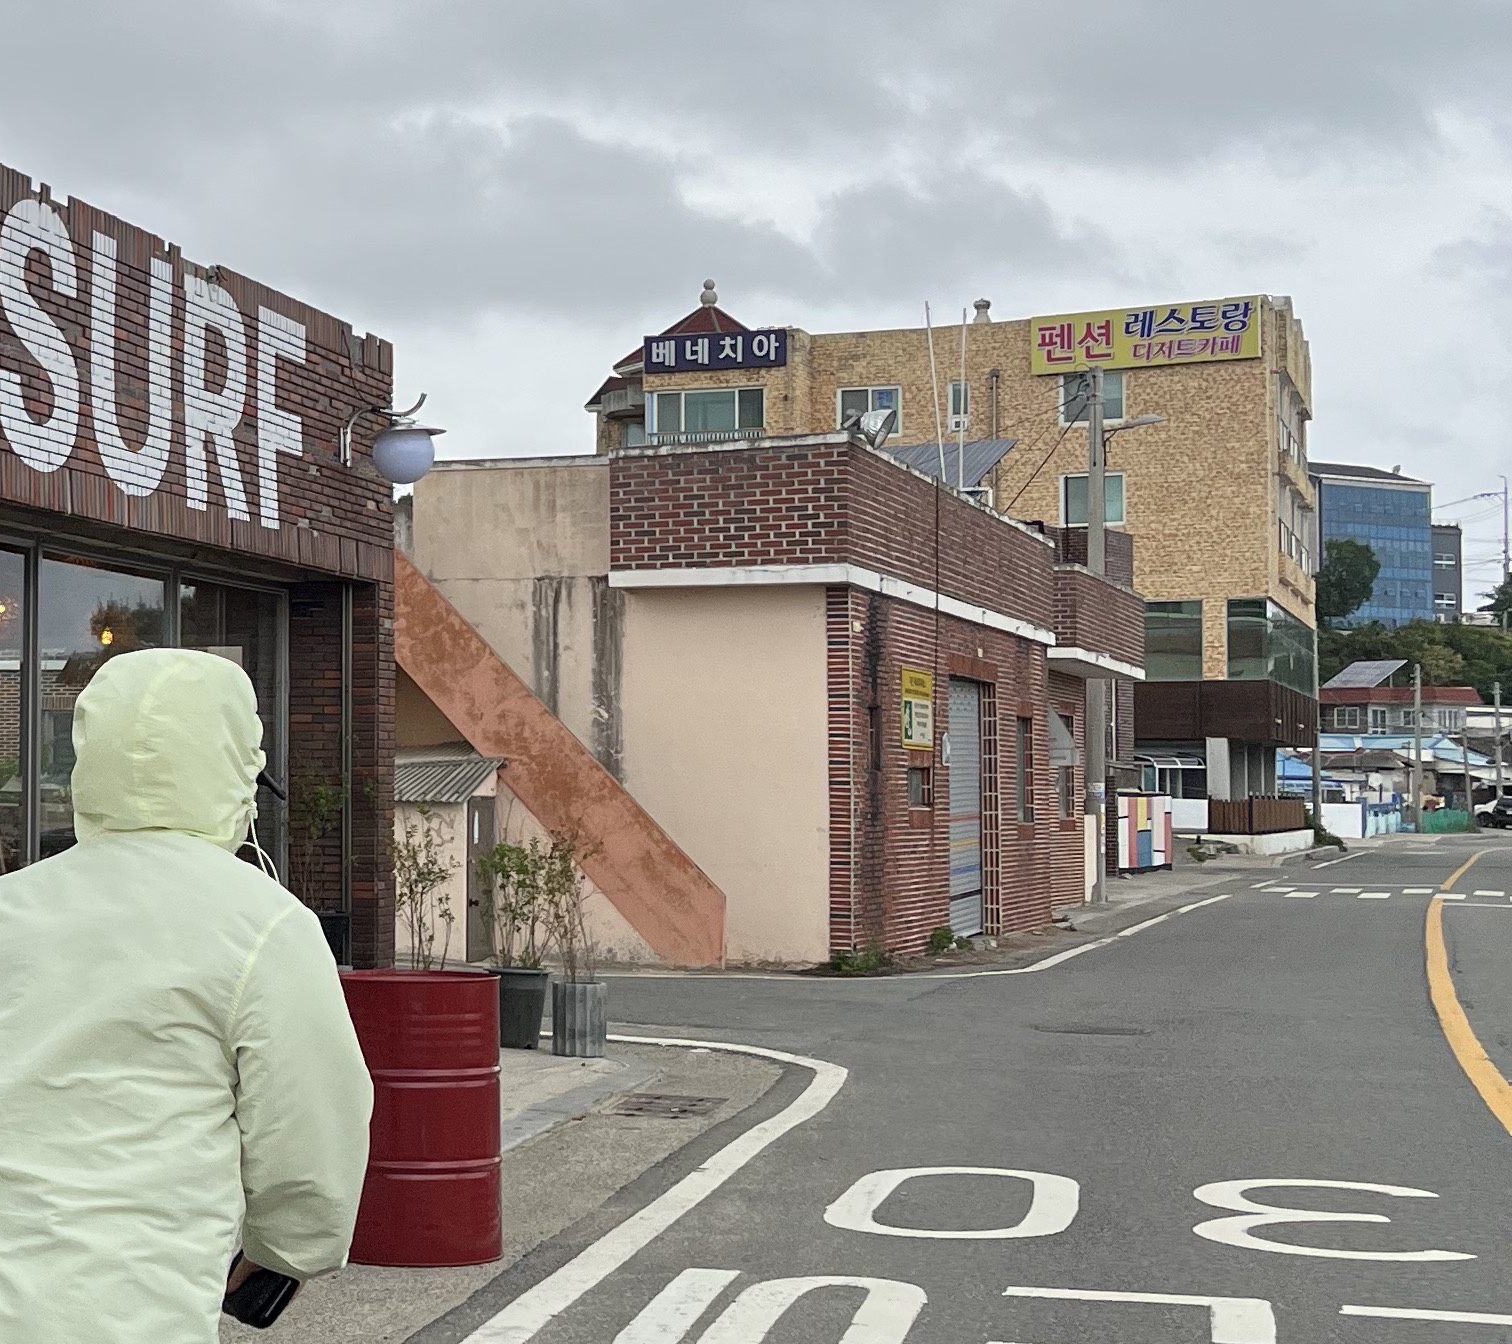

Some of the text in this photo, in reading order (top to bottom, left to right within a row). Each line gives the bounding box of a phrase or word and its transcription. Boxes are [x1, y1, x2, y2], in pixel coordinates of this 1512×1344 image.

[1125, 301, 1254, 338] 레스토랑
[651, 334, 780, 367] 베네치아
[1037, 319, 1113, 363] 펜션
[1132, 334, 1242, 361] 디저트카페
[823, 1166, 1479, 1262] 30
